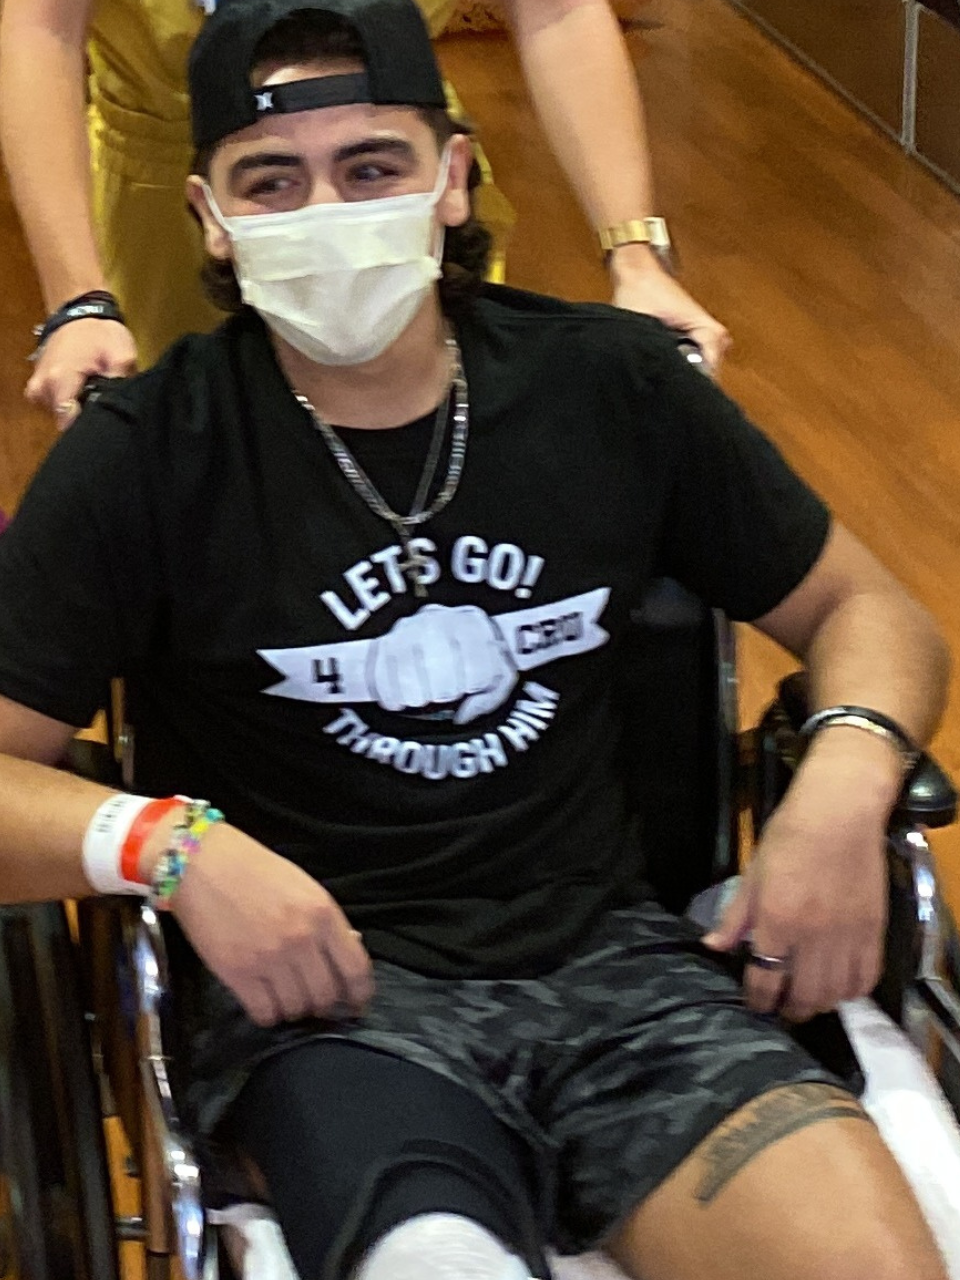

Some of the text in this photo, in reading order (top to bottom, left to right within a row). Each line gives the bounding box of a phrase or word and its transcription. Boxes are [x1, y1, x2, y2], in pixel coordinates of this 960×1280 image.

[451, 535, 546, 600] GO!
[311, 657, 344, 695] 4
[321, 680, 562, 780] THROUGH HIM
